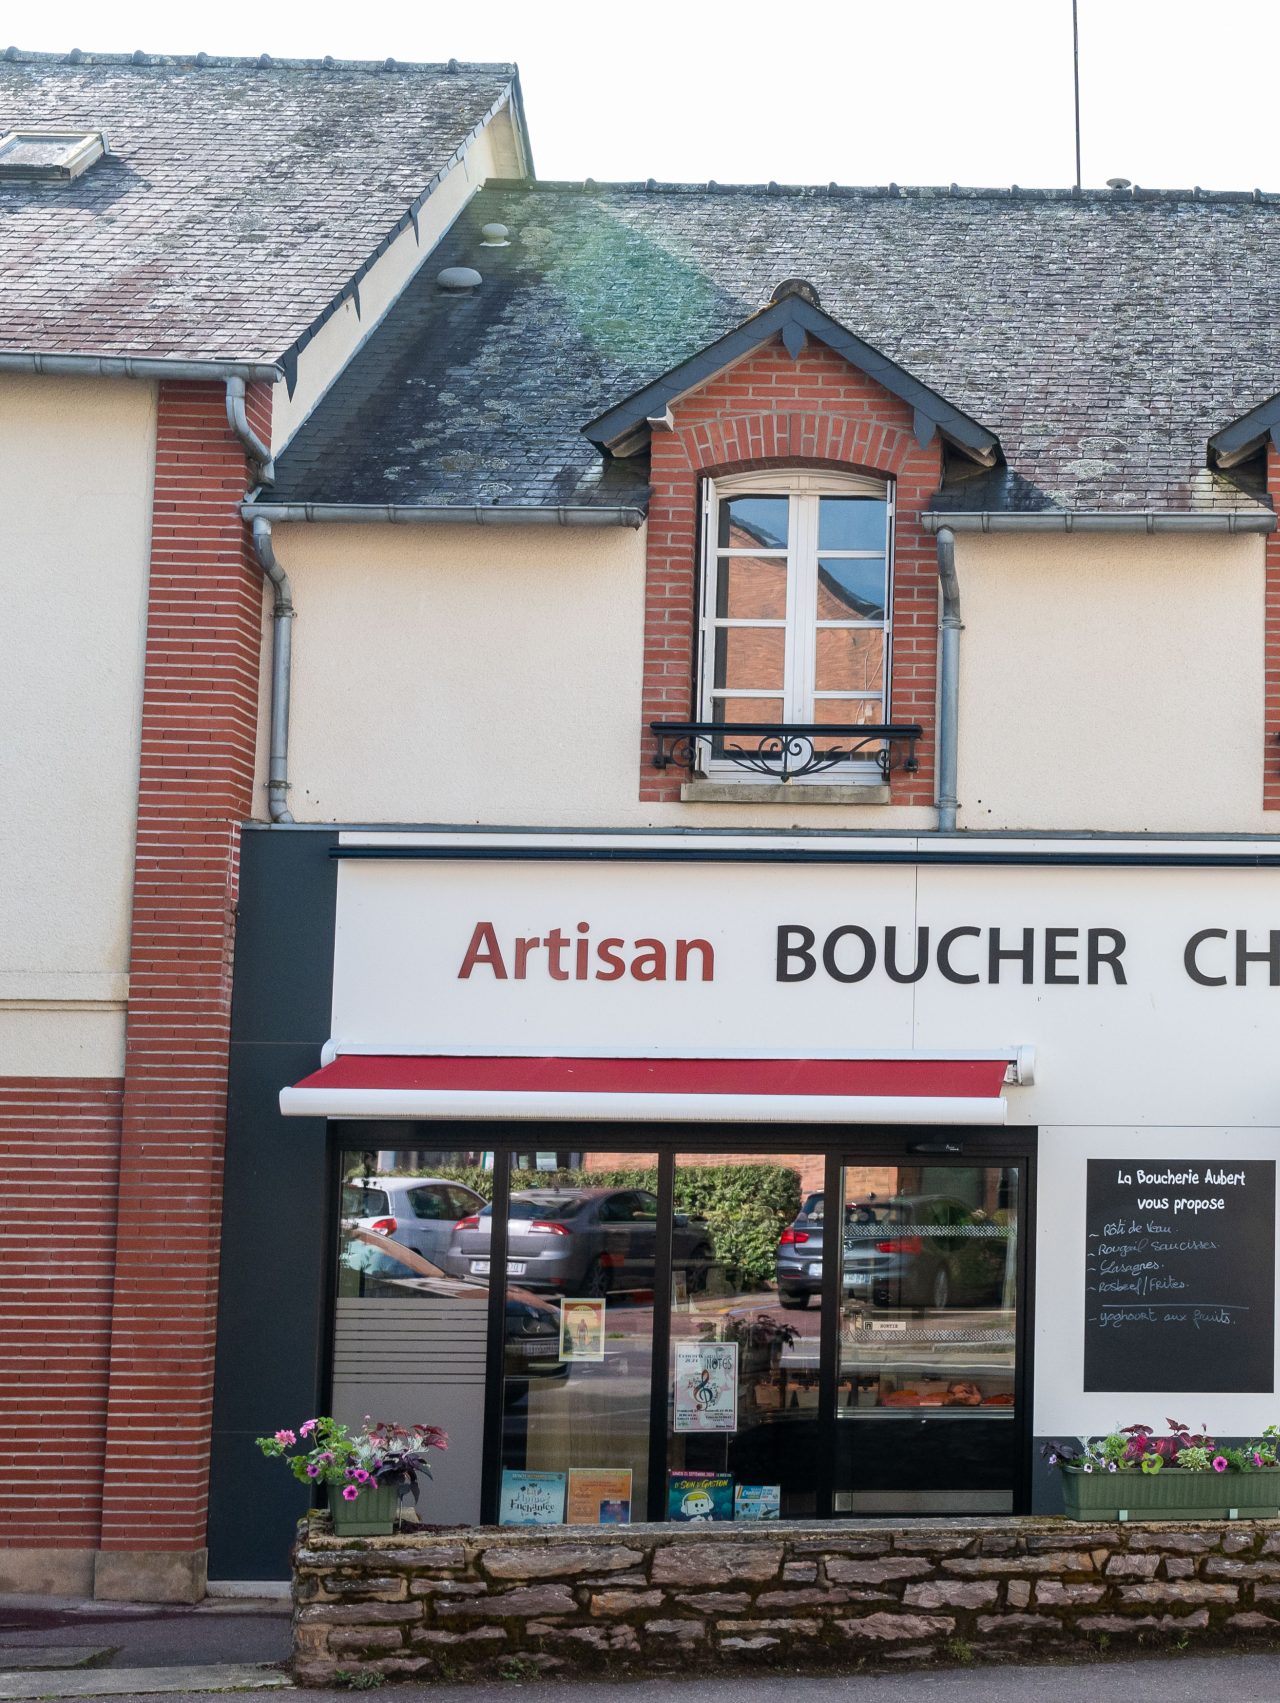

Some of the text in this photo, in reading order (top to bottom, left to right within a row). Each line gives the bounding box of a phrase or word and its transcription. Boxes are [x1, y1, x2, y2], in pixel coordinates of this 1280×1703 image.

[457, 921, 715, 982] Artisan
[776, 924, 1128, 985] BOUCHER
[1117, 1169, 1246, 1186] La Boucherie Aubert
[1137, 1198, 1225, 1215] vous propose
[1128, 1220, 1142, 1234] de
[1163, 1312, 1187, 1321] aux
